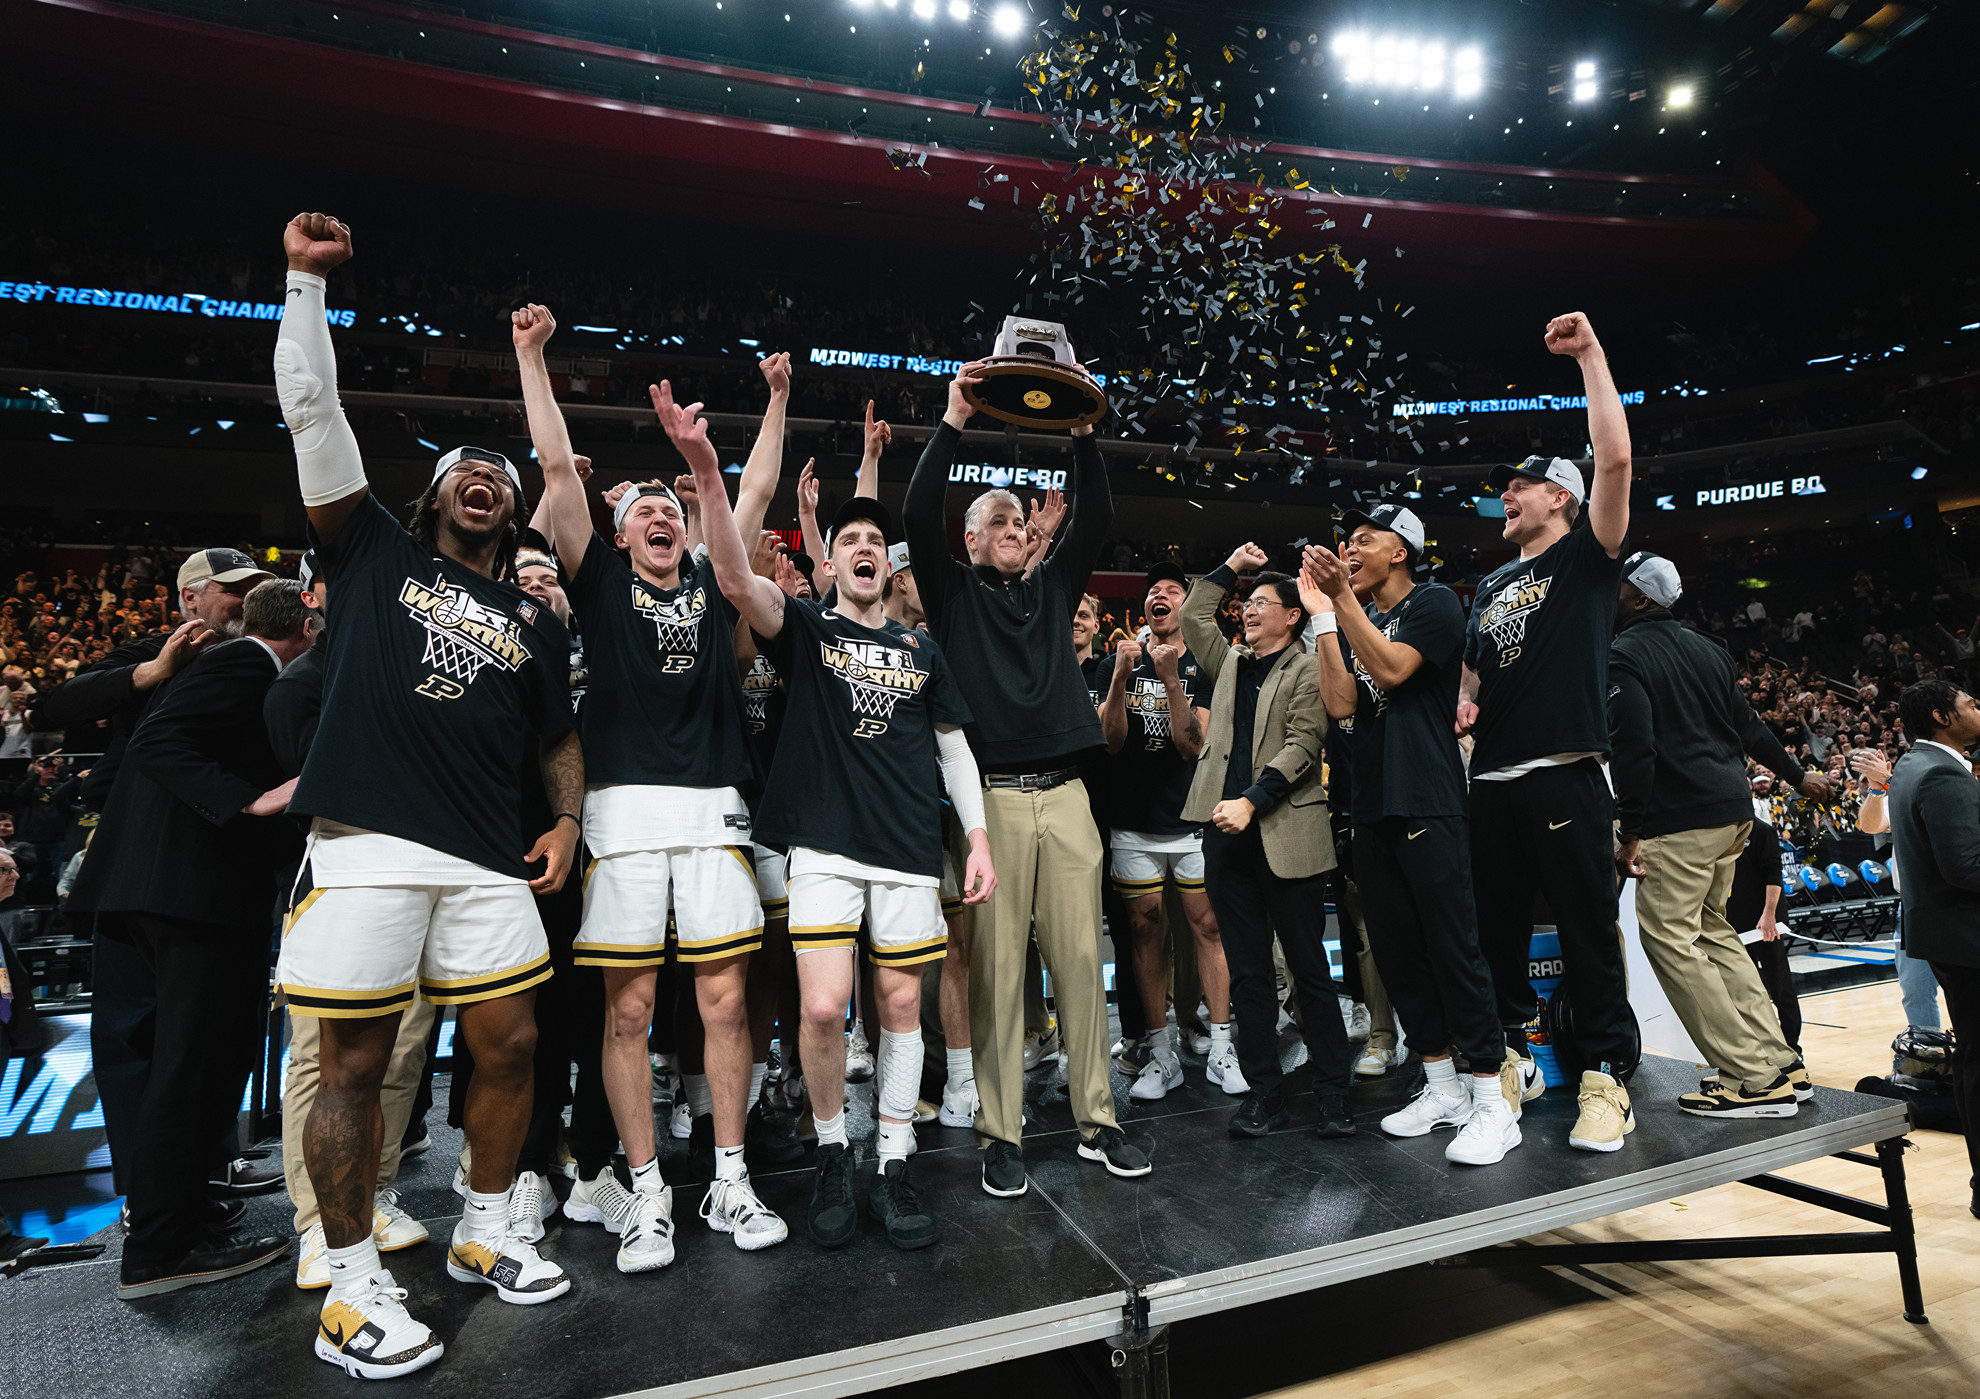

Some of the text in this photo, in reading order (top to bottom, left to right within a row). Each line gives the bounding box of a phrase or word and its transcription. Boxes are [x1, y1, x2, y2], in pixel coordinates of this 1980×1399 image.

[55, 286, 193, 313] REGIONAL
[201, 298, 356, 328] CHAMPNS
[810, 347, 899, 371] MIDWEST
[1393, 391, 1645, 416] MIDWEST REGIONAL CHAMNS
[1696, 480, 1783, 506] PURDUE
[403, 583, 526, 667] WORTHY
[661, 654, 695, 674] P
[844, 643, 903, 668] NET
[1499, 646, 1522, 668] P
[824, 646, 925, 692] WORTHY
[414, 674, 465, 702] P
[852, 718, 889, 739] P
[1144, 737, 1167, 752] P
[492, 1262, 517, 1287] 55
[347, 1329, 377, 1350] P
